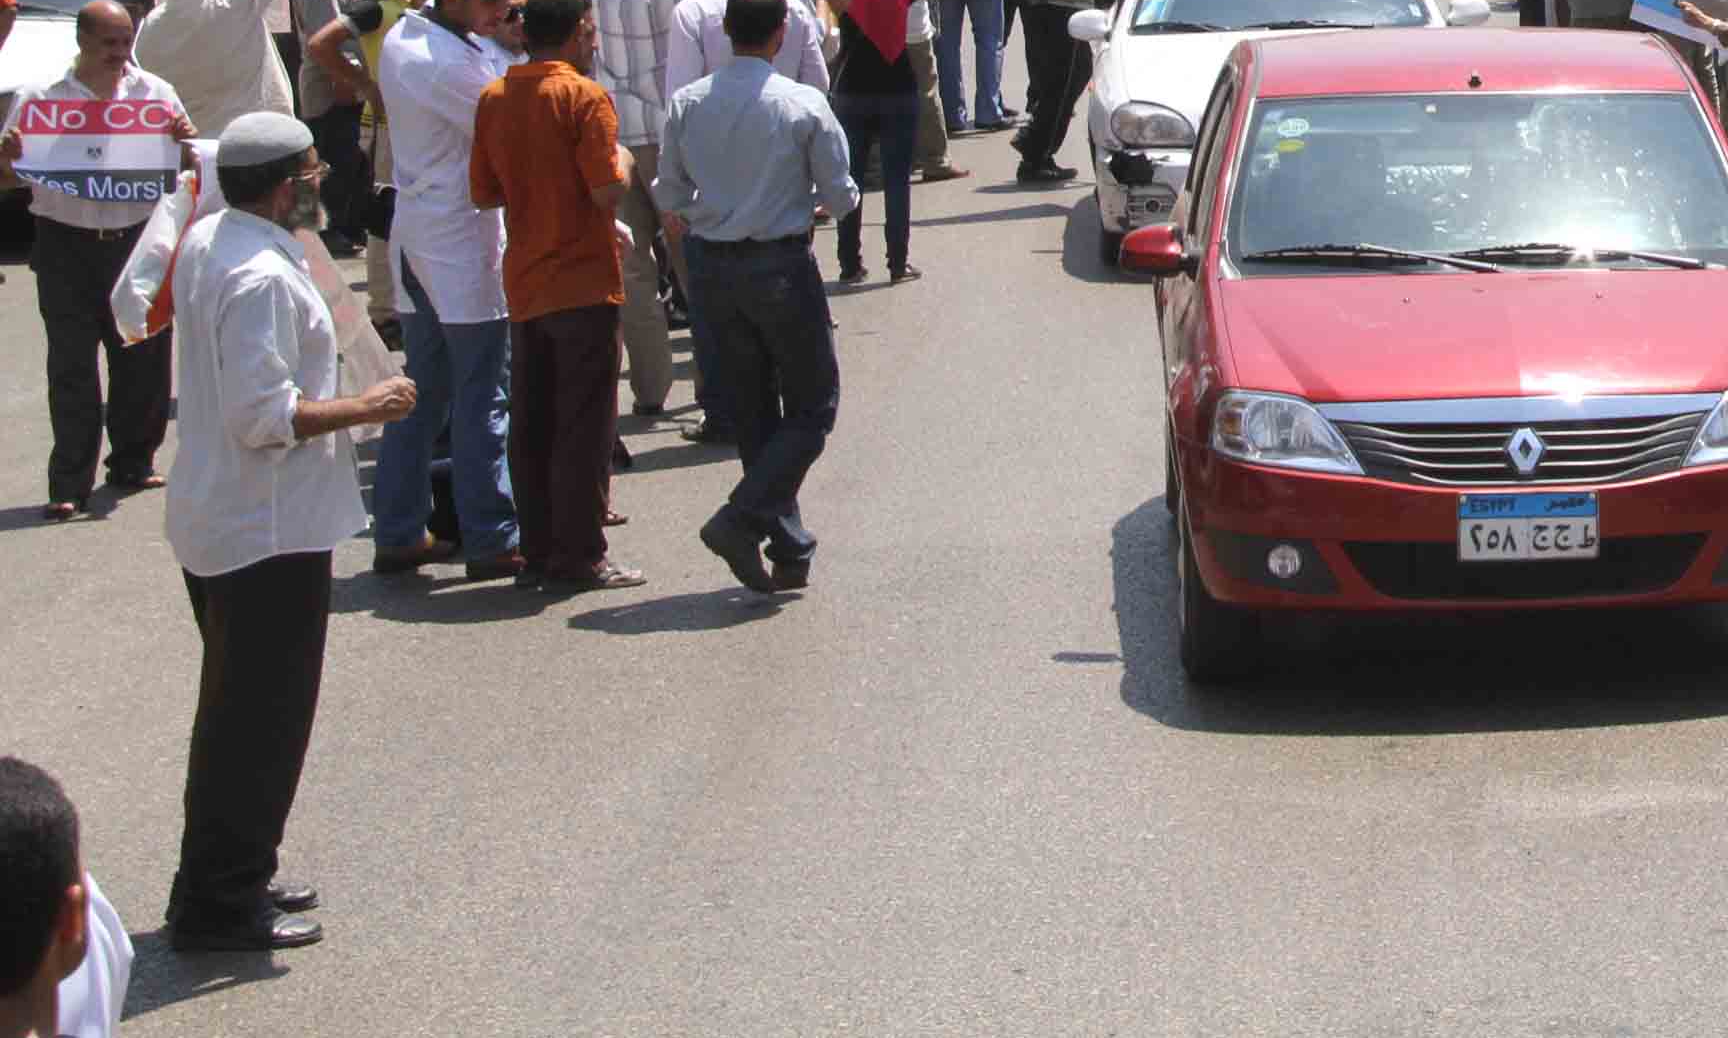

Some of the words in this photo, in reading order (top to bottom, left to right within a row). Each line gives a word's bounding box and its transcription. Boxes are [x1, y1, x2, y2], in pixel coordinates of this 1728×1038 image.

[26, 102, 87, 130] No
[103, 102, 170, 129] CC
[88, 173, 165, 200] Morsi
